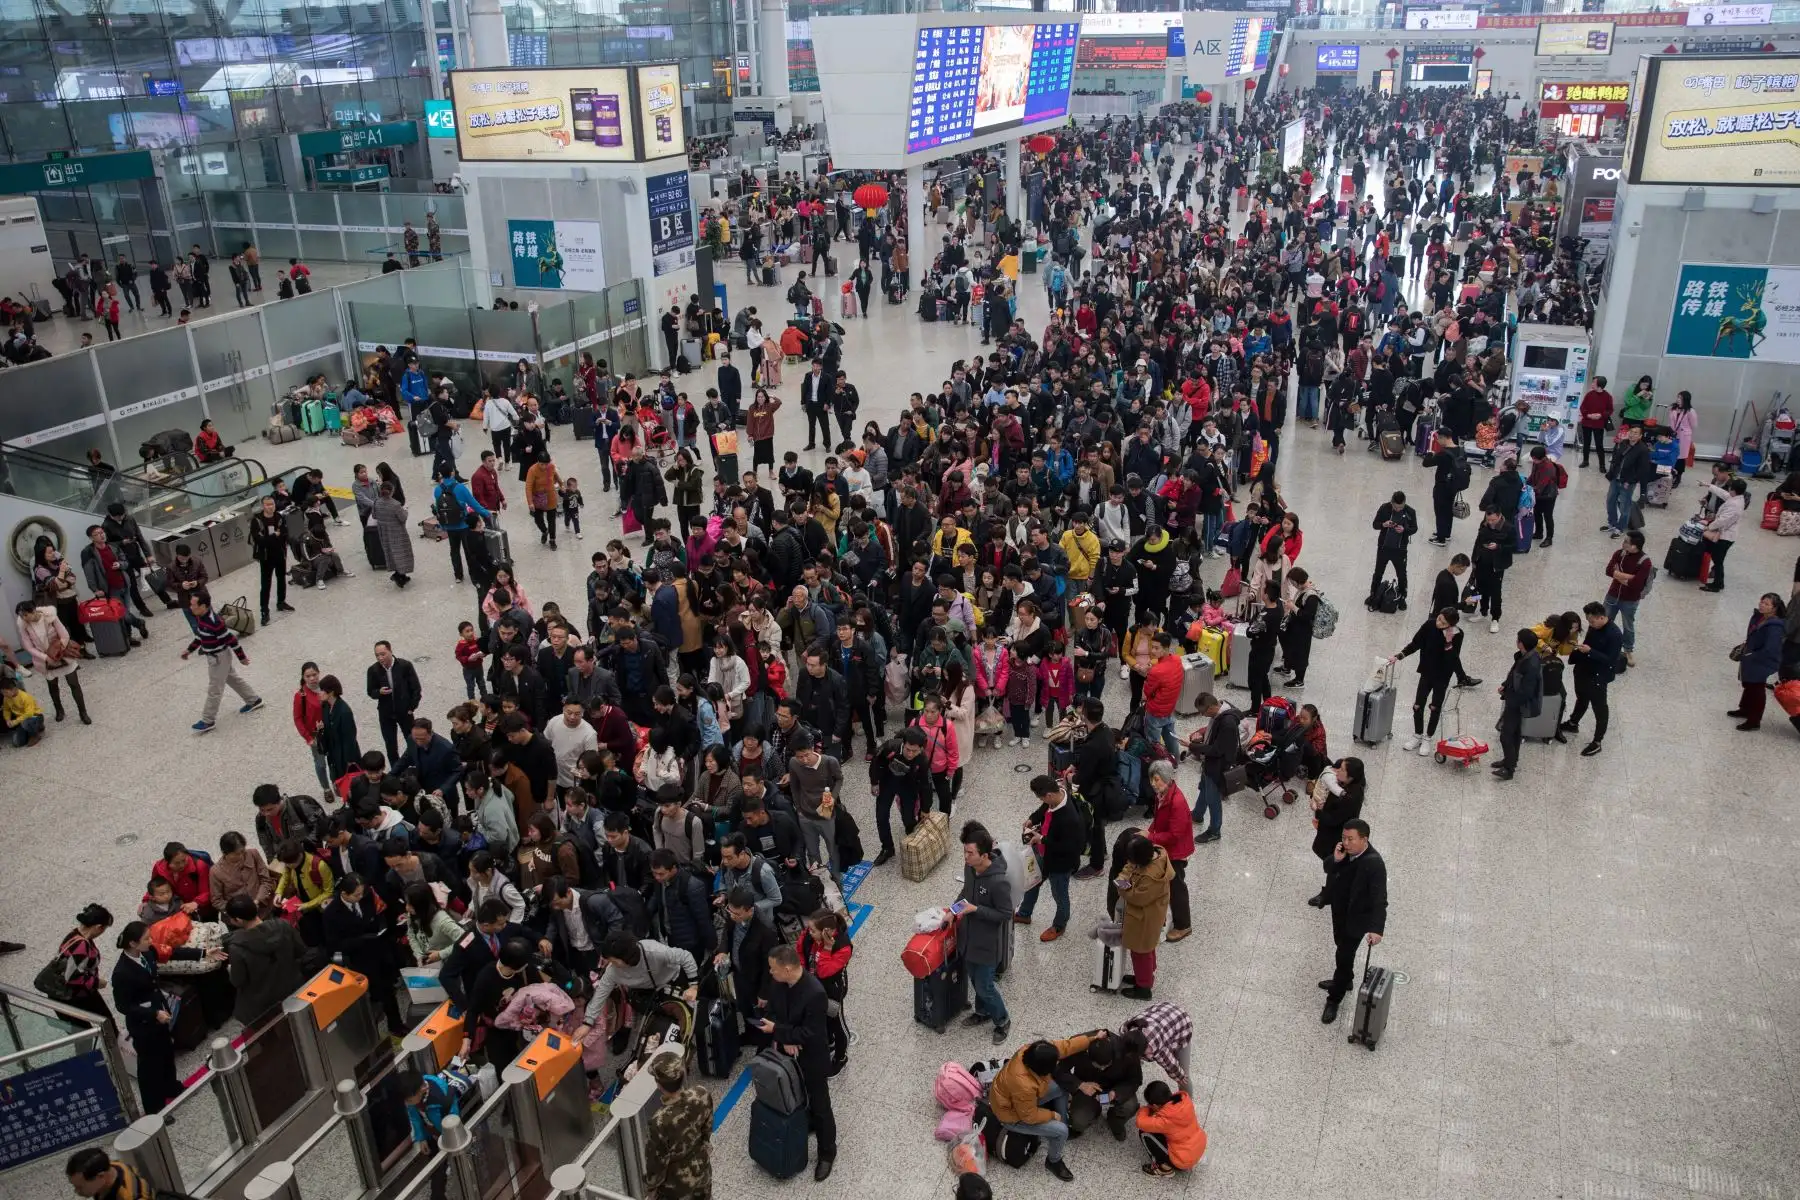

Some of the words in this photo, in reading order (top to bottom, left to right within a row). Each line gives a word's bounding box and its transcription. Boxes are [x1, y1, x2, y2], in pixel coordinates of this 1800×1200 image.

[1193, 40, 1222, 55] A区
[1566, 86, 1628, 100] 绝味鸭脖
[1668, 108, 1800, 137] 放松，就嚼松子
[354, 132, 366, 141] 出口
[368, 129, 382, 144] A1
[64, 164, 84, 174] 出口
[1682, 280, 1729, 299] 路铁
[1680, 299, 1727, 317] 传媒
